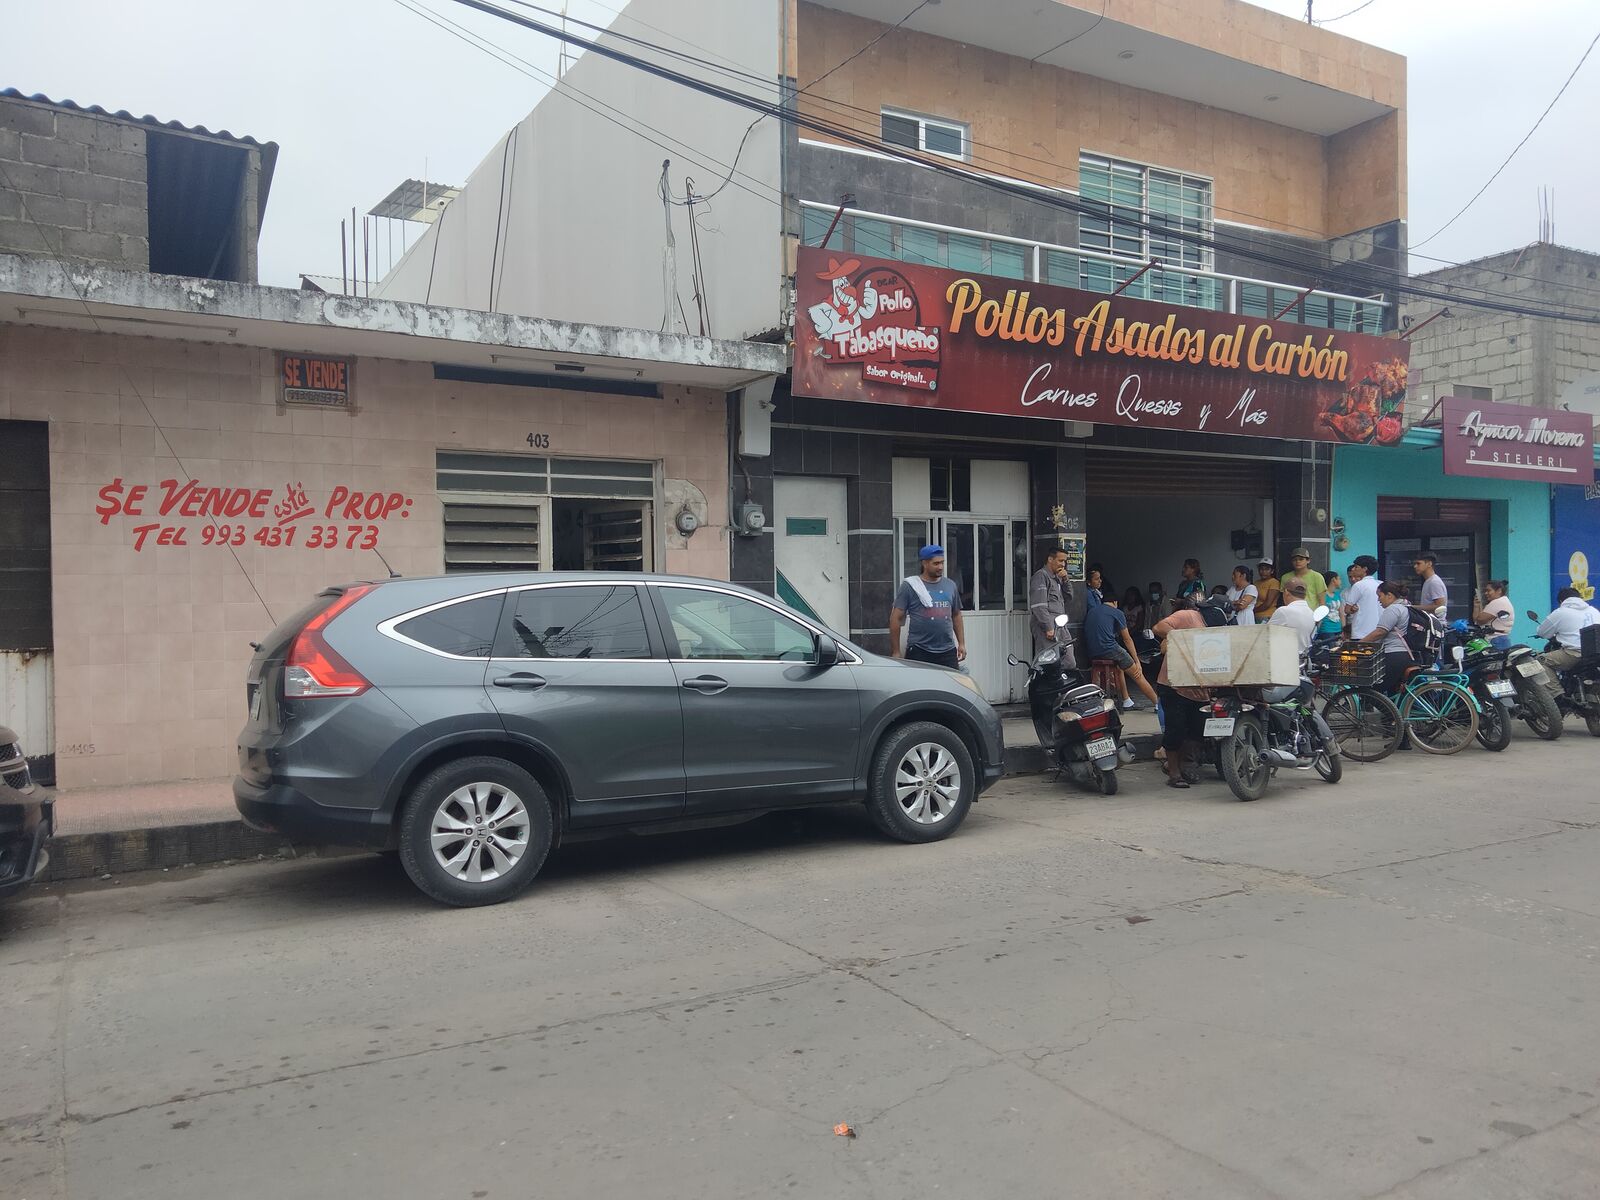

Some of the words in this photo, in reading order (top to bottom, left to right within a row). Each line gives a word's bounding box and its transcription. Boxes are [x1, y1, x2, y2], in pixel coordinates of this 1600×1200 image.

[878, 288, 912, 313] Pollo
[833, 325, 939, 358] Tabasqueño
[945, 278, 1066, 346] Pollos
[1072, 300, 1204, 364] Asados
[1209, 323, 1247, 368] al
[1246, 324, 1349, 383] Carbón
[285, 358, 301, 387] SE
[305, 359, 346, 390] VENDE
[1020, 363, 1099, 408] Carnes
[1115, 374, 1183, 422] Quesos
[1200, 406, 1211, 429] y
[1225, 387, 1268, 428] Más
[526, 432, 550, 449] 403
[1521, 417, 1585, 447] Morena
[158, 479, 273, 518] VENDE
[274, 481, 310, 519] está
[325, 486, 413, 520] PROP:
[132, 523, 187, 552] TEL
[201, 524, 247, 546] 993
[254, 525, 297, 547] 431
